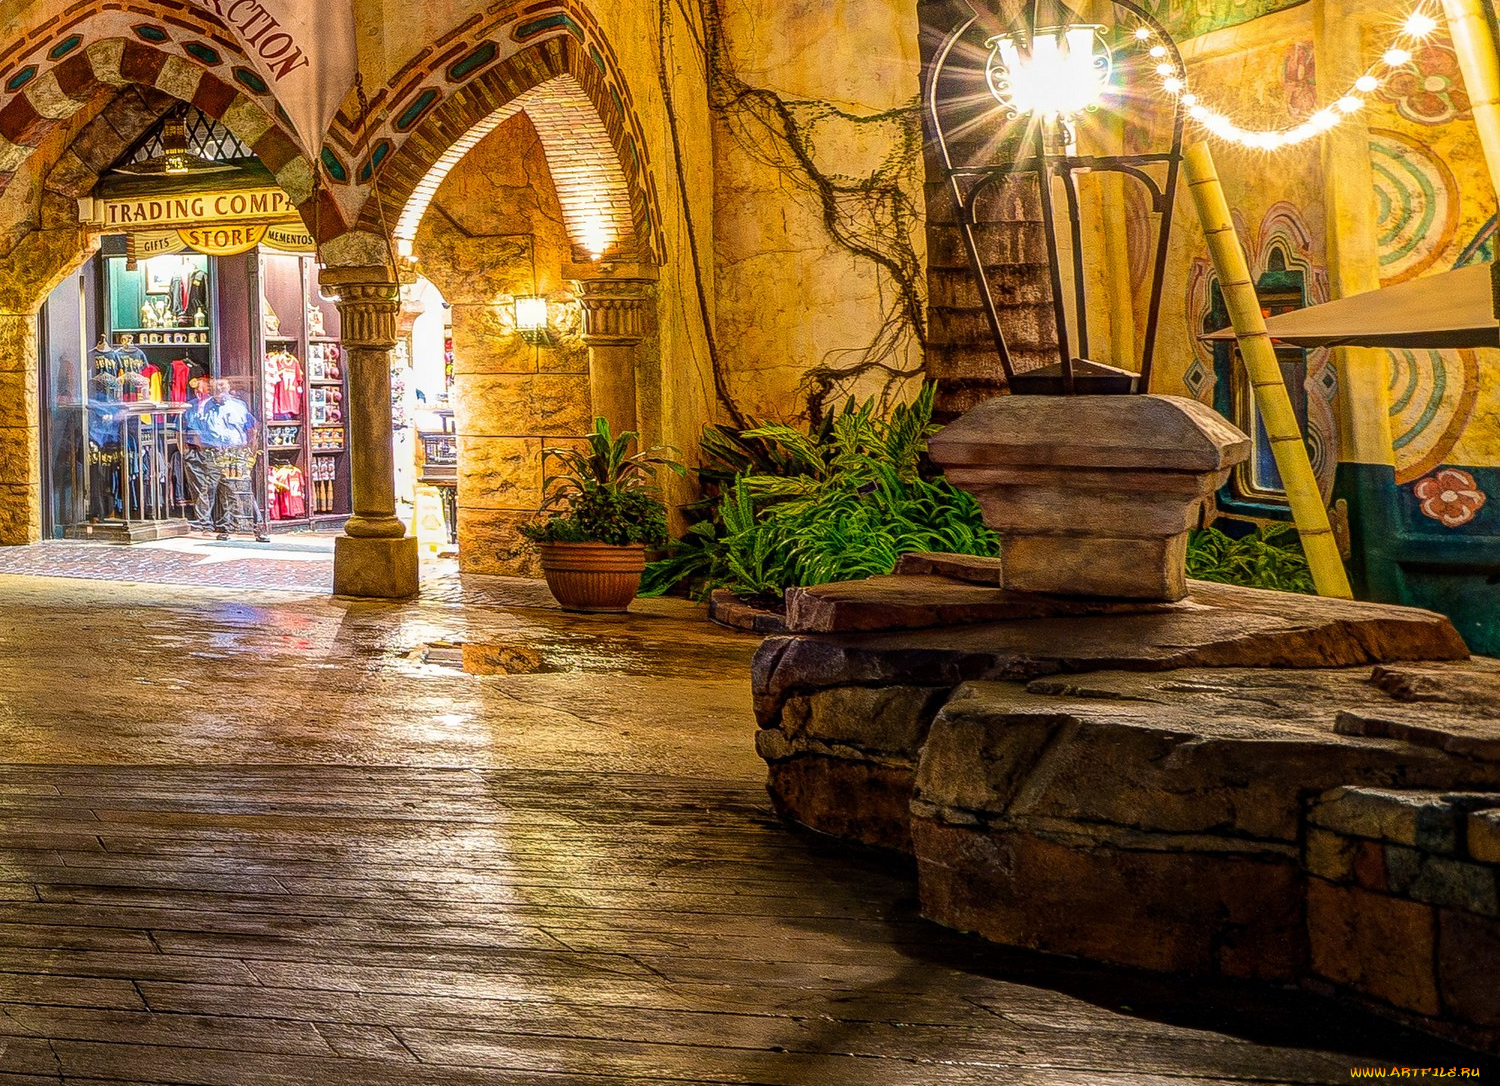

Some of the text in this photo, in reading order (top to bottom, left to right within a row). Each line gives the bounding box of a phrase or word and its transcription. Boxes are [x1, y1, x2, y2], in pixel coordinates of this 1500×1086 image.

[109, 198, 204, 223] TRADING
[144, 237, 170, 252] GIFTS
[190, 227, 256, 248] STORE
[268, 230, 313, 245] MEMENTOS
